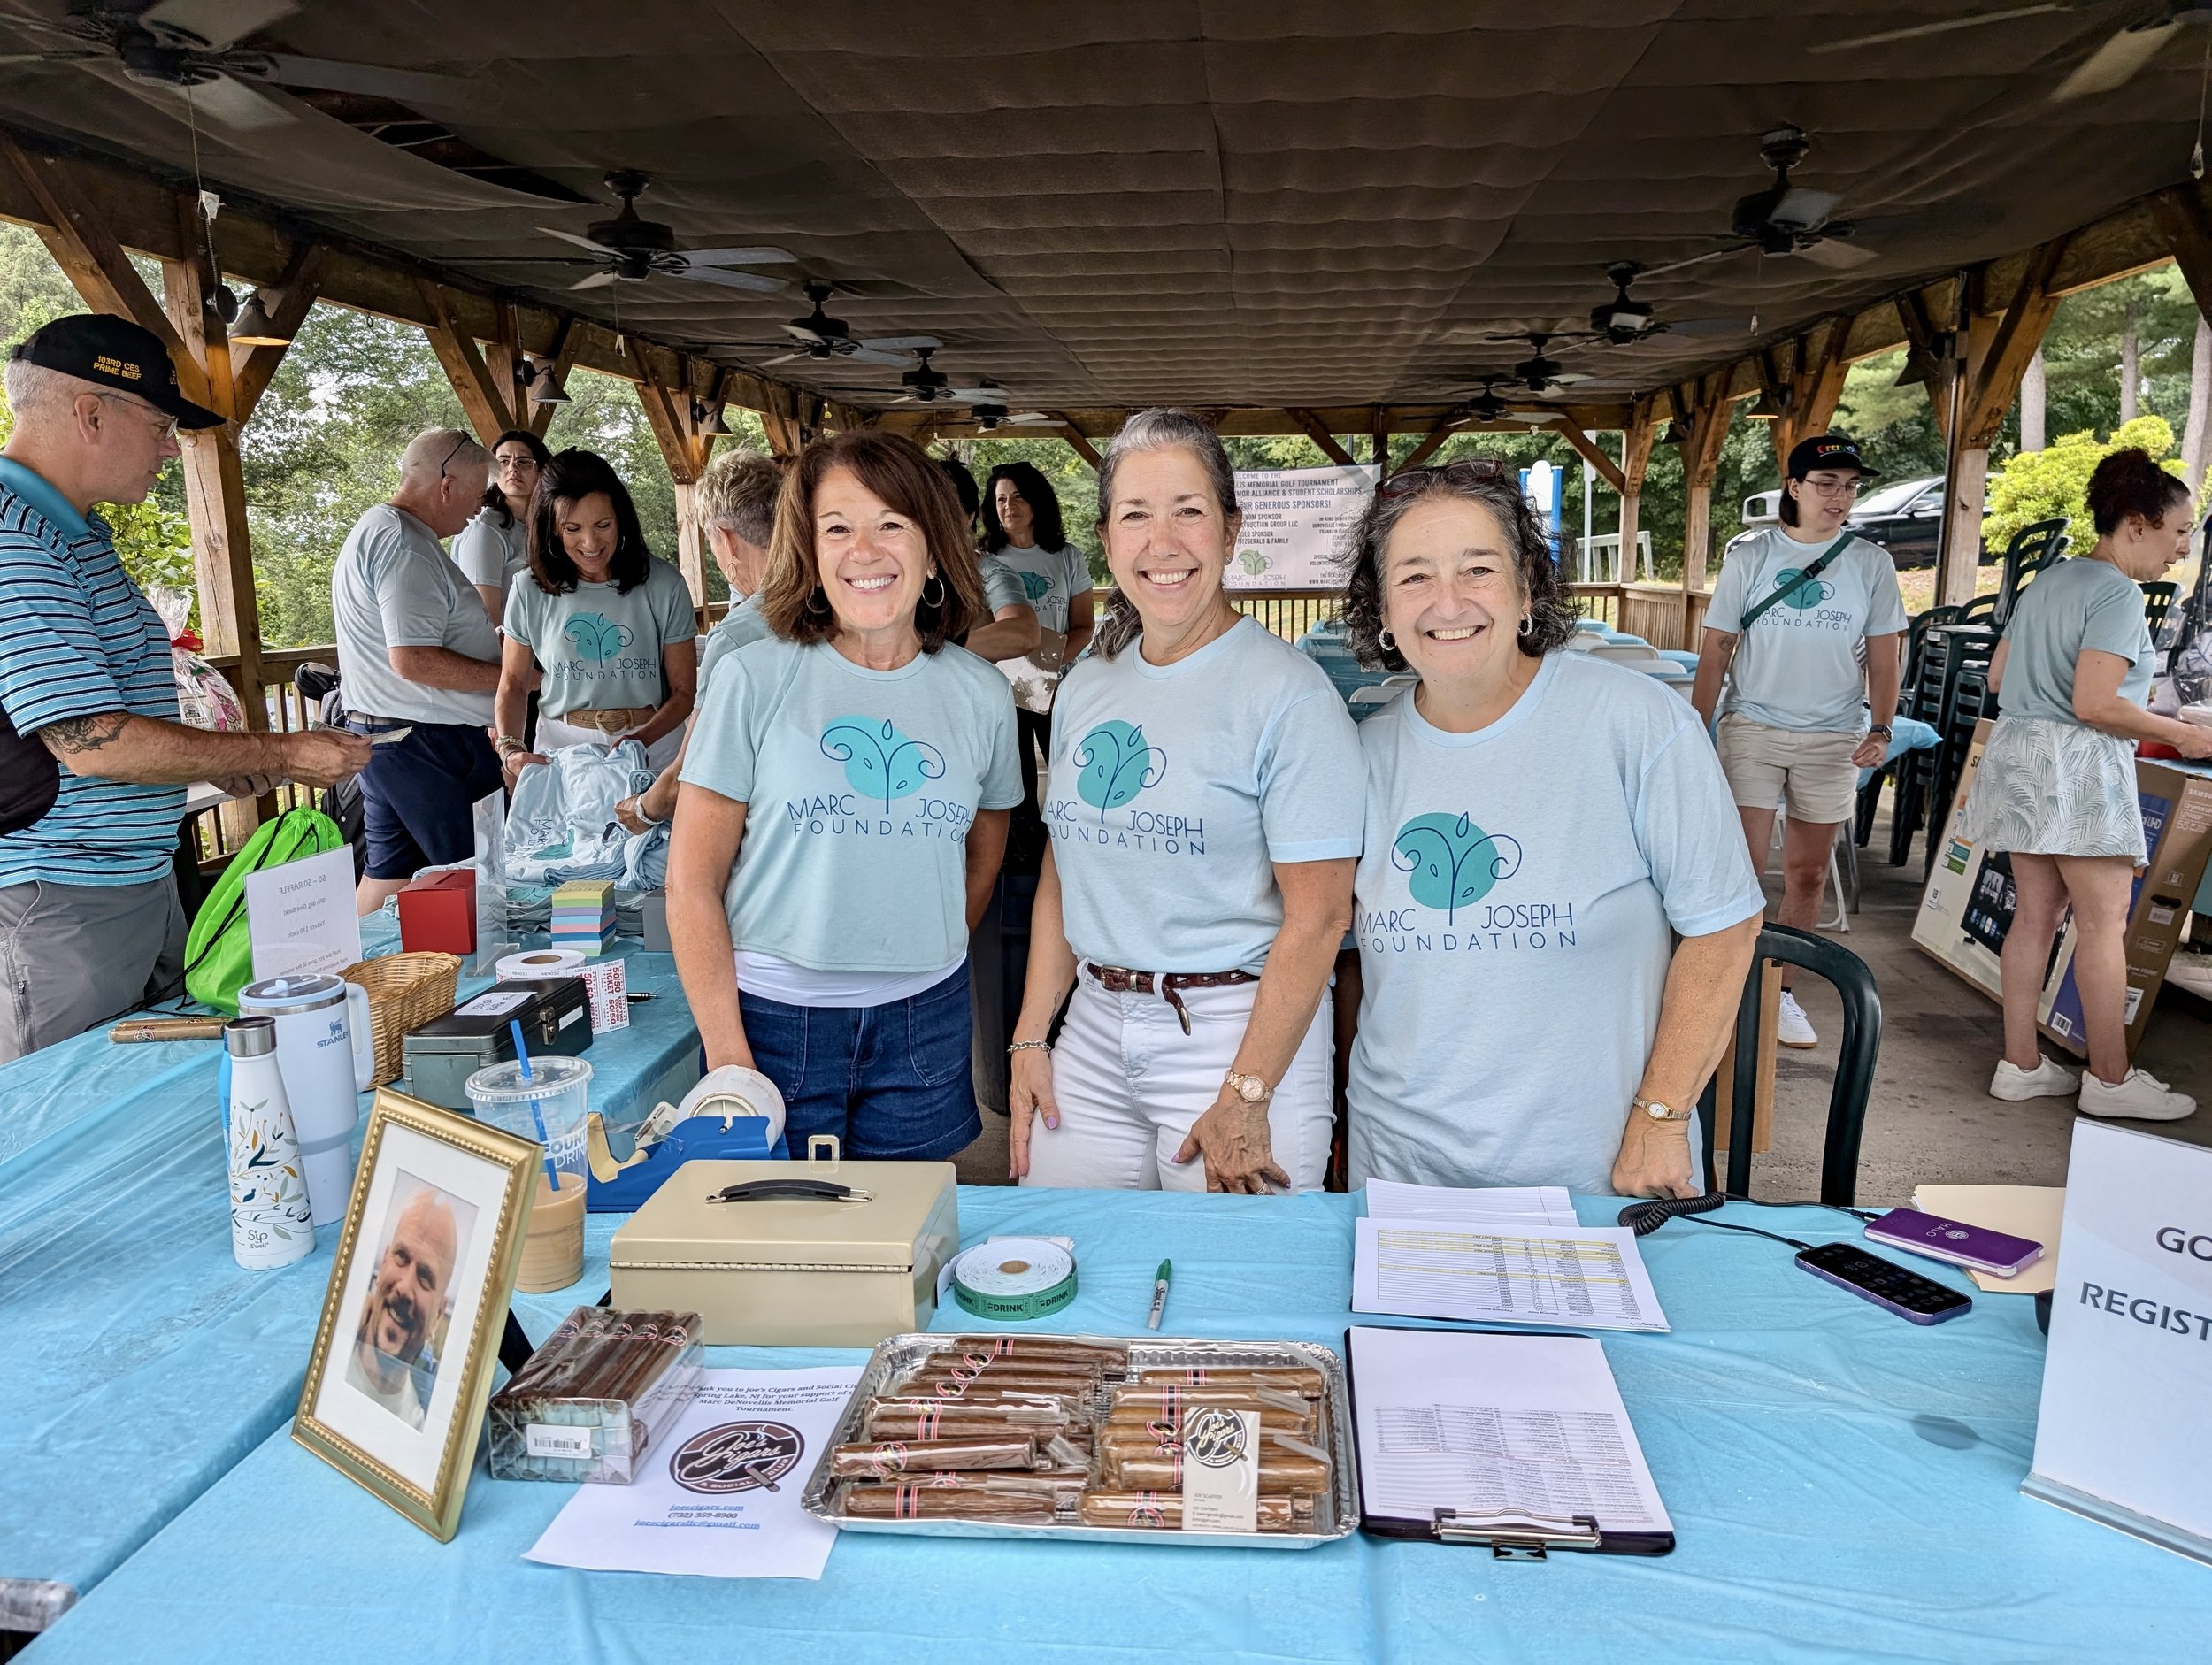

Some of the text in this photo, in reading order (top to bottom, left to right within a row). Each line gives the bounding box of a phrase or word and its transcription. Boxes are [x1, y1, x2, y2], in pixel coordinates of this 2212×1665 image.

[93, 363, 142, 380] PRIME BEEF
[97, 355, 140, 372] 103RD CES
[1255, 501, 1290, 510] GENEROUS
[1293, 500, 1331, 509] SPONSORS!
[1813, 610, 1852, 624] JOSEPH
[553, 658, 656, 672] MARC JOSEPH
[555, 671, 657, 681] FOUNDATION
[787, 794, 972, 830] MARC JOSEPH
[794, 819, 967, 845] FOUNDATION
[1126, 810, 1203, 838] JOSEPH
[1358, 902, 1573, 934] MARC JOSEPH
[1360, 931, 1576, 954] FOUNDATION
[316, 1030, 349, 1048] STANLEY
[248, 1230, 268, 1243] Sip
[1926, 1223, 1952, 1237] HALO
[1046, 1290, 1069, 1306] DRINK
[2079, 1280, 2212, 1341] REGIST
[710, 1480, 753, 1489] SOCIAL
[767, 1458, 789, 1476] CLUB
[634, 1519, 760, 1529] joescigarsllc@gmail.com
